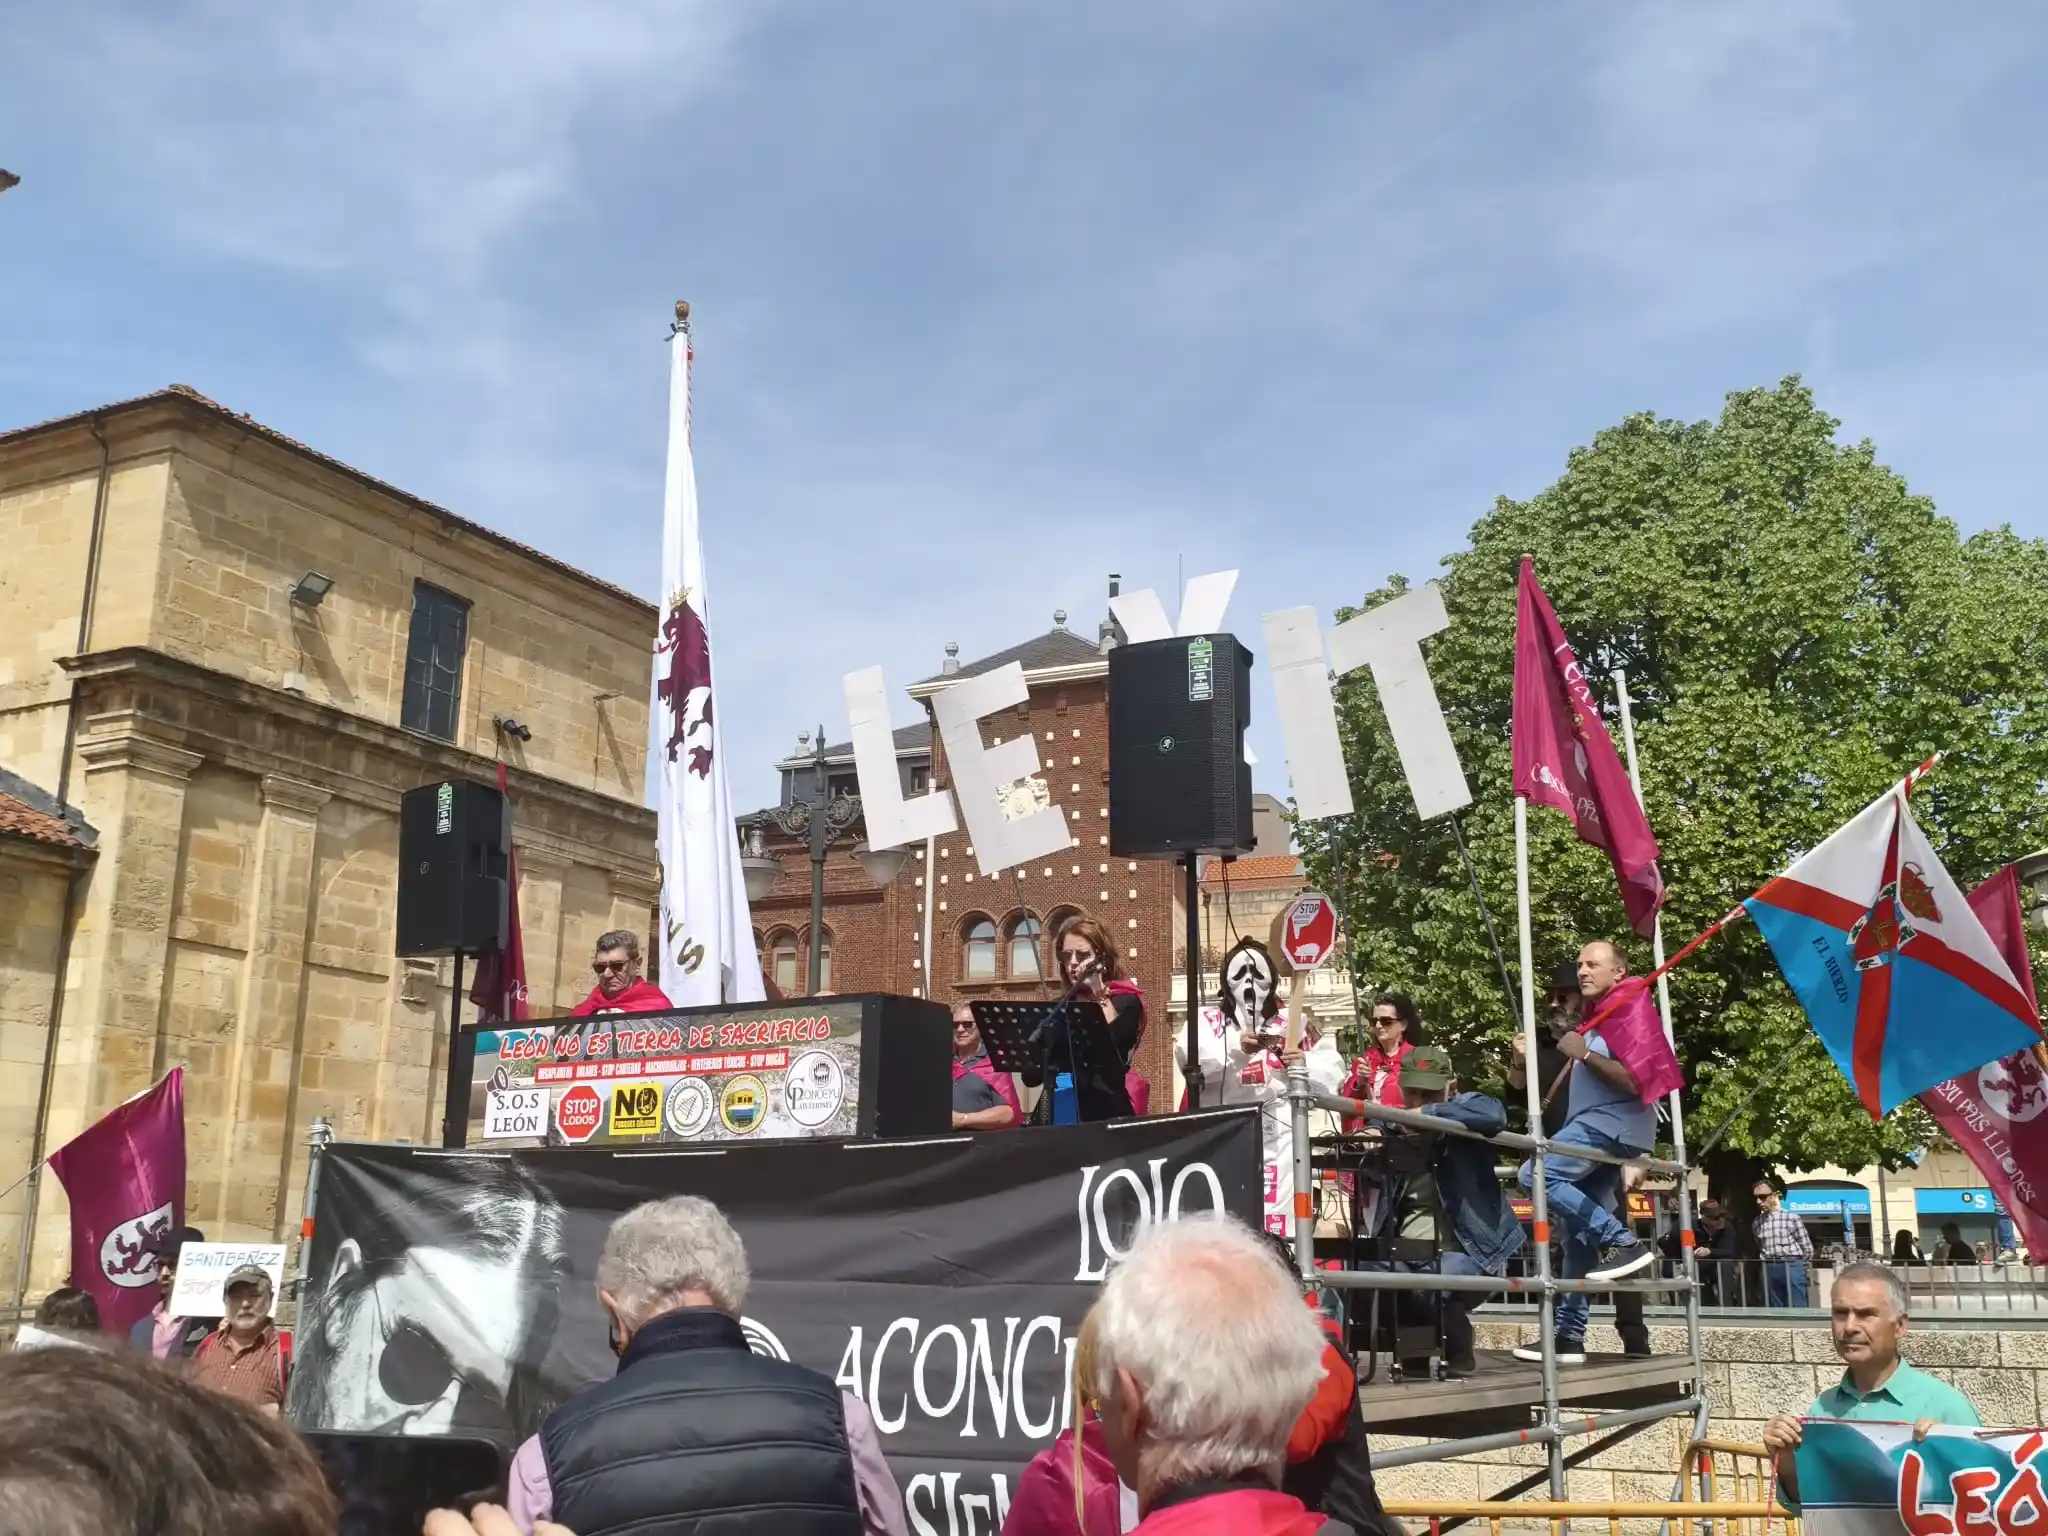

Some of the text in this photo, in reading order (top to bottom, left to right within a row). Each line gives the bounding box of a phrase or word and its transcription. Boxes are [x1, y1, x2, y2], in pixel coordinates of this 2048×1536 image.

[1300, 904, 1319, 914] STOP
[499, 1016, 830, 1060] LEÓN NO ES TIERRA DE SACRIFICIO
[496, 1093, 539, 1110] S.O.S
[565, 1098, 598, 1115] STOP
[615, 1088, 658, 1117] NO
[492, 1112, 539, 1133] LEÓN
[563, 1115, 595, 1126] LODOS
